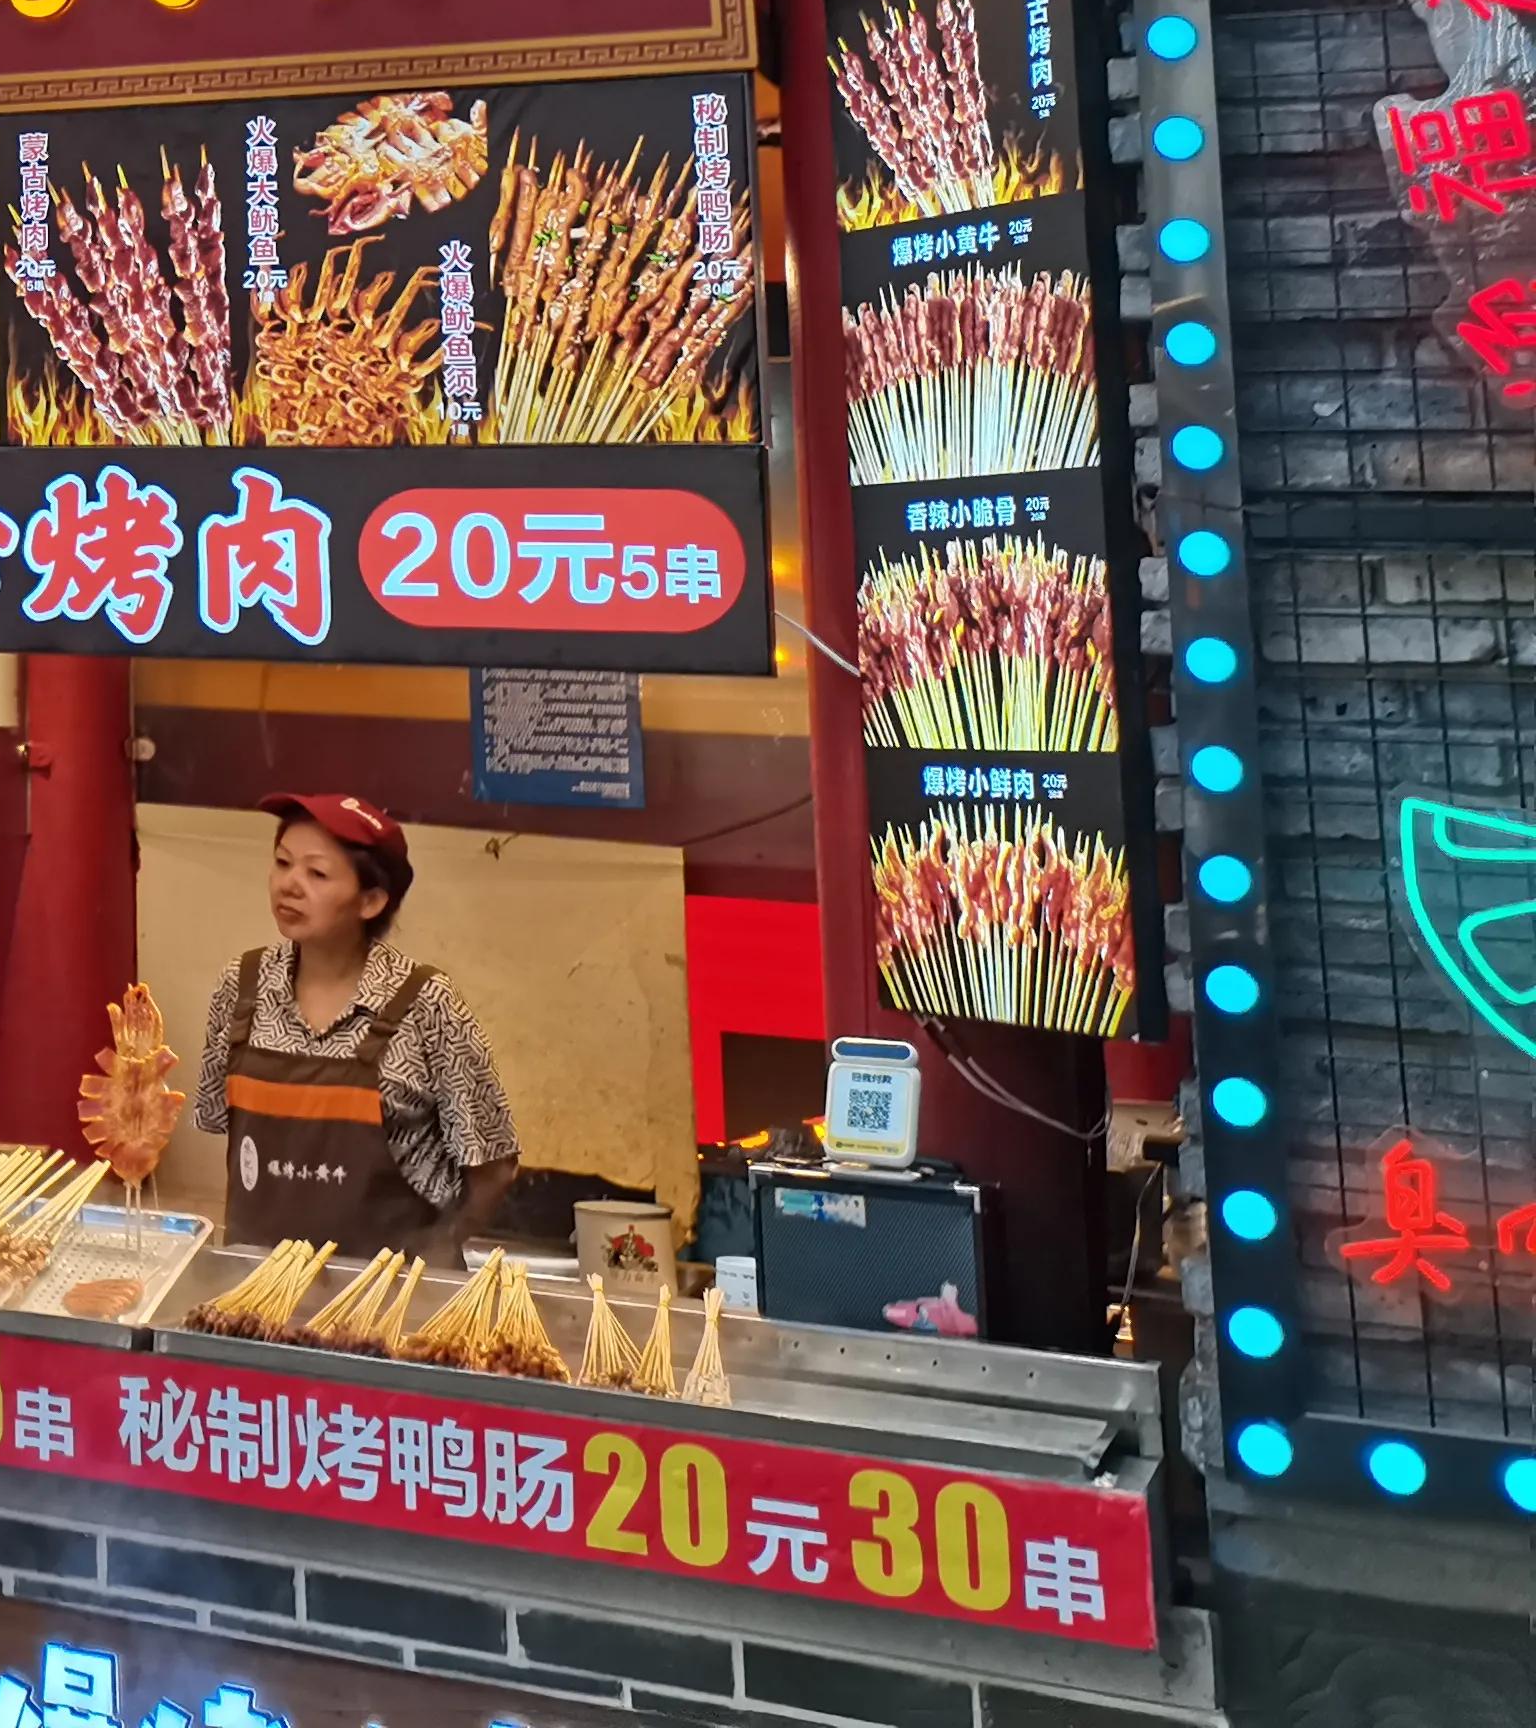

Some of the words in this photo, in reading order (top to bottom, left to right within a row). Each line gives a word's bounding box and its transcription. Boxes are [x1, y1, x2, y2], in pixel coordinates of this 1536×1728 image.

[1031, 91, 1057, 110] 20元
[692, 93, 733, 256] 秘制烤鸭肠
[18, 132, 50, 252] 蒙古烤肉
[246, 115, 280, 268] 火爆大鱿鱼
[1008, 217, 1034, 236] 20元
[892, 221, 1001, 267] 爆烤小黄牛
[15, 259, 56, 280] 20元
[242, 268, 287, 290] 20元
[692, 259, 743, 282] 20元
[439, 240, 478, 397] 火爆鱿鱼须
[436, 401, 482, 422] 10元
[907, 498, 1016, 533] 香辣小脆骨
[1025, 496, 1050, 512] 20元
[923, 766, 1035, 800] 爆烤小鲜肉
[1043, 772, 1068, 791] 20元
